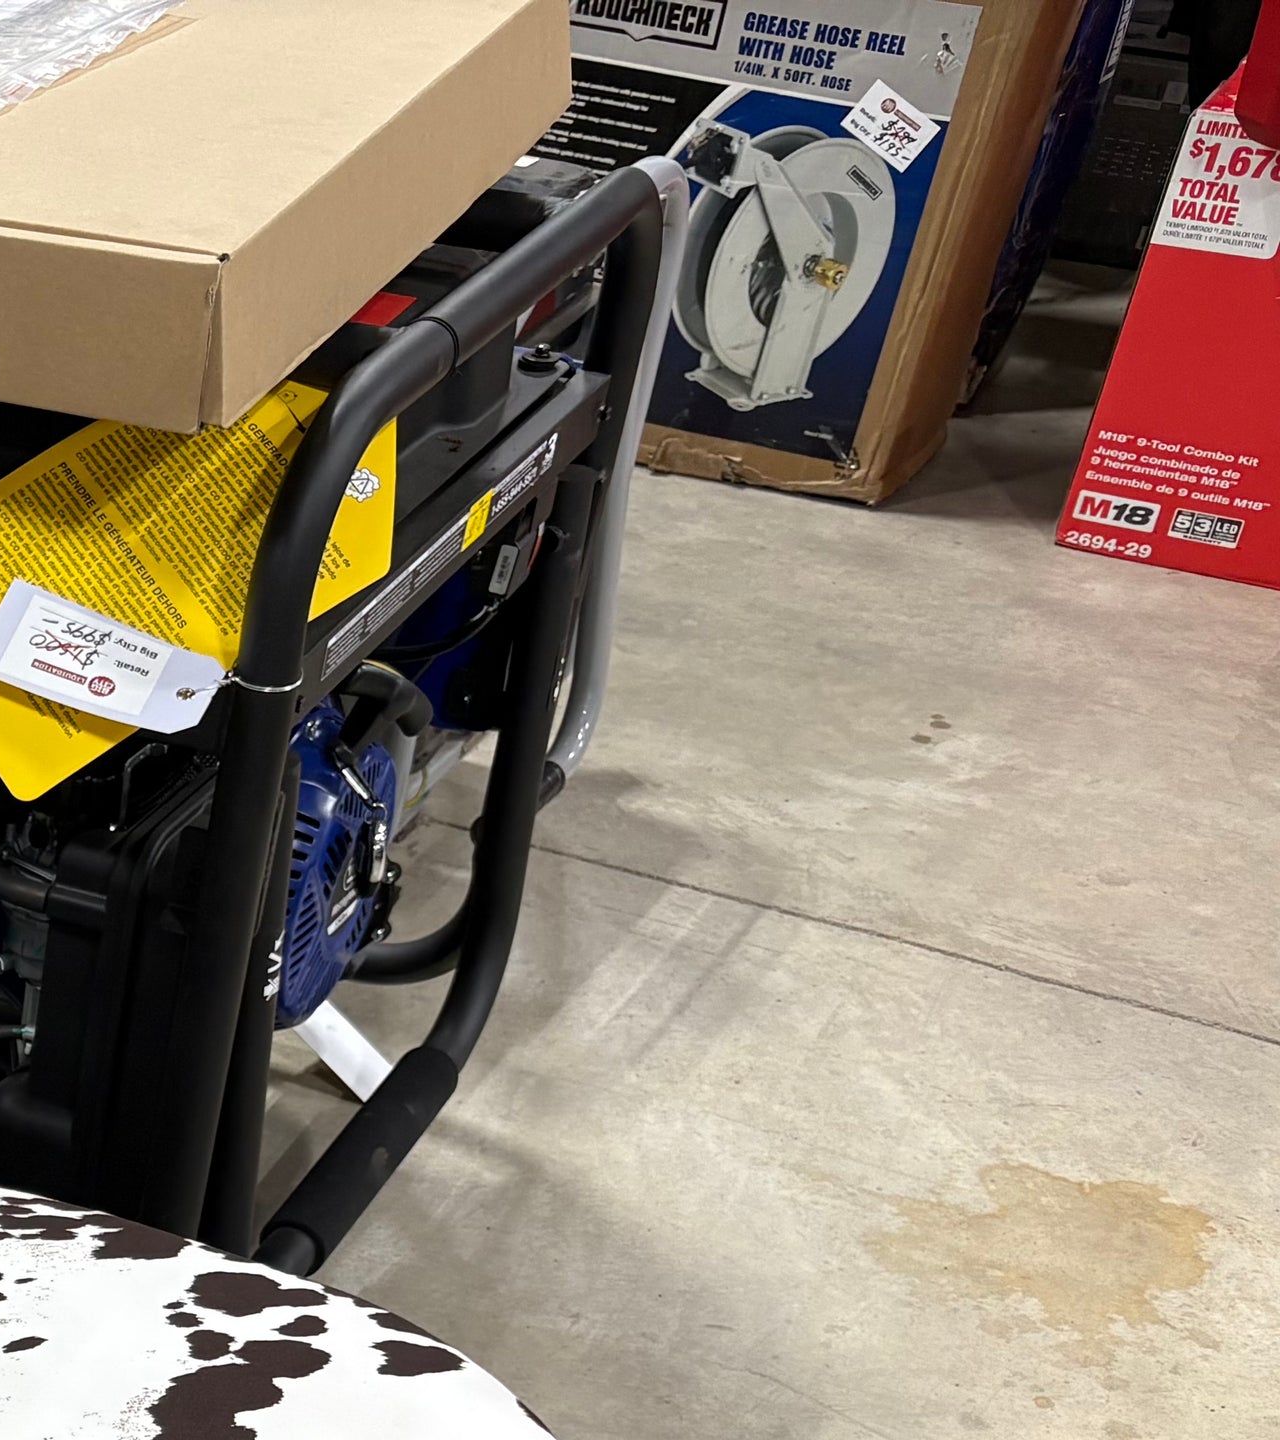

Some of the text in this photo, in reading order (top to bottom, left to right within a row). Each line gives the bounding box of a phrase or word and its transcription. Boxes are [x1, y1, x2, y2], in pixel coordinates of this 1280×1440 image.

[744, 12, 906, 56] GREASE HOSE REEL
[738, 36, 836, 70] WITH HOSE
[734, 60, 852, 92] 1/4IN. X 50FT. HOSE
[1179, 178, 1240, 204] TOTAL
[1171, 199, 1239, 226] VALUE
[1252, 232, 1268, 241] TOTAL
[246, 422, 289, 467] GENERAD
[1137, 437, 1181, 453] 9-Tool
[1183, 445, 1235, 463] Combo
[1238, 454, 1259, 467] Kit
[1091, 456, 1101, 465] 9
[1104, 458, 1198, 484] herramientas
[1093, 445, 1241, 480] Juego combinado de
[1085, 470, 1153, 491] Ensemble
[1155, 483, 1175, 495] de
[1178, 488, 1189, 497] 9
[1191, 490, 1230, 506] outils
[1078, 495, 1155, 526] M18
[1174, 515, 1192, 529] 5
[1194, 518, 1212, 533] 3
[1215, 521, 1239, 535] LED
[56, 461, 188, 629] PRENDRE LE GÉNÉRATEUR DEHORS
[1064, 530, 1153, 559] 2694-29
[112, 636, 137, 652] City:
[138, 646, 158, 659] Big
[32, 659, 86, 684] LIQUIDATION
[112, 658, 149, 677] Retail:
[89, 682, 110, 695] BIG
[90, 676, 114, 690] CITY
